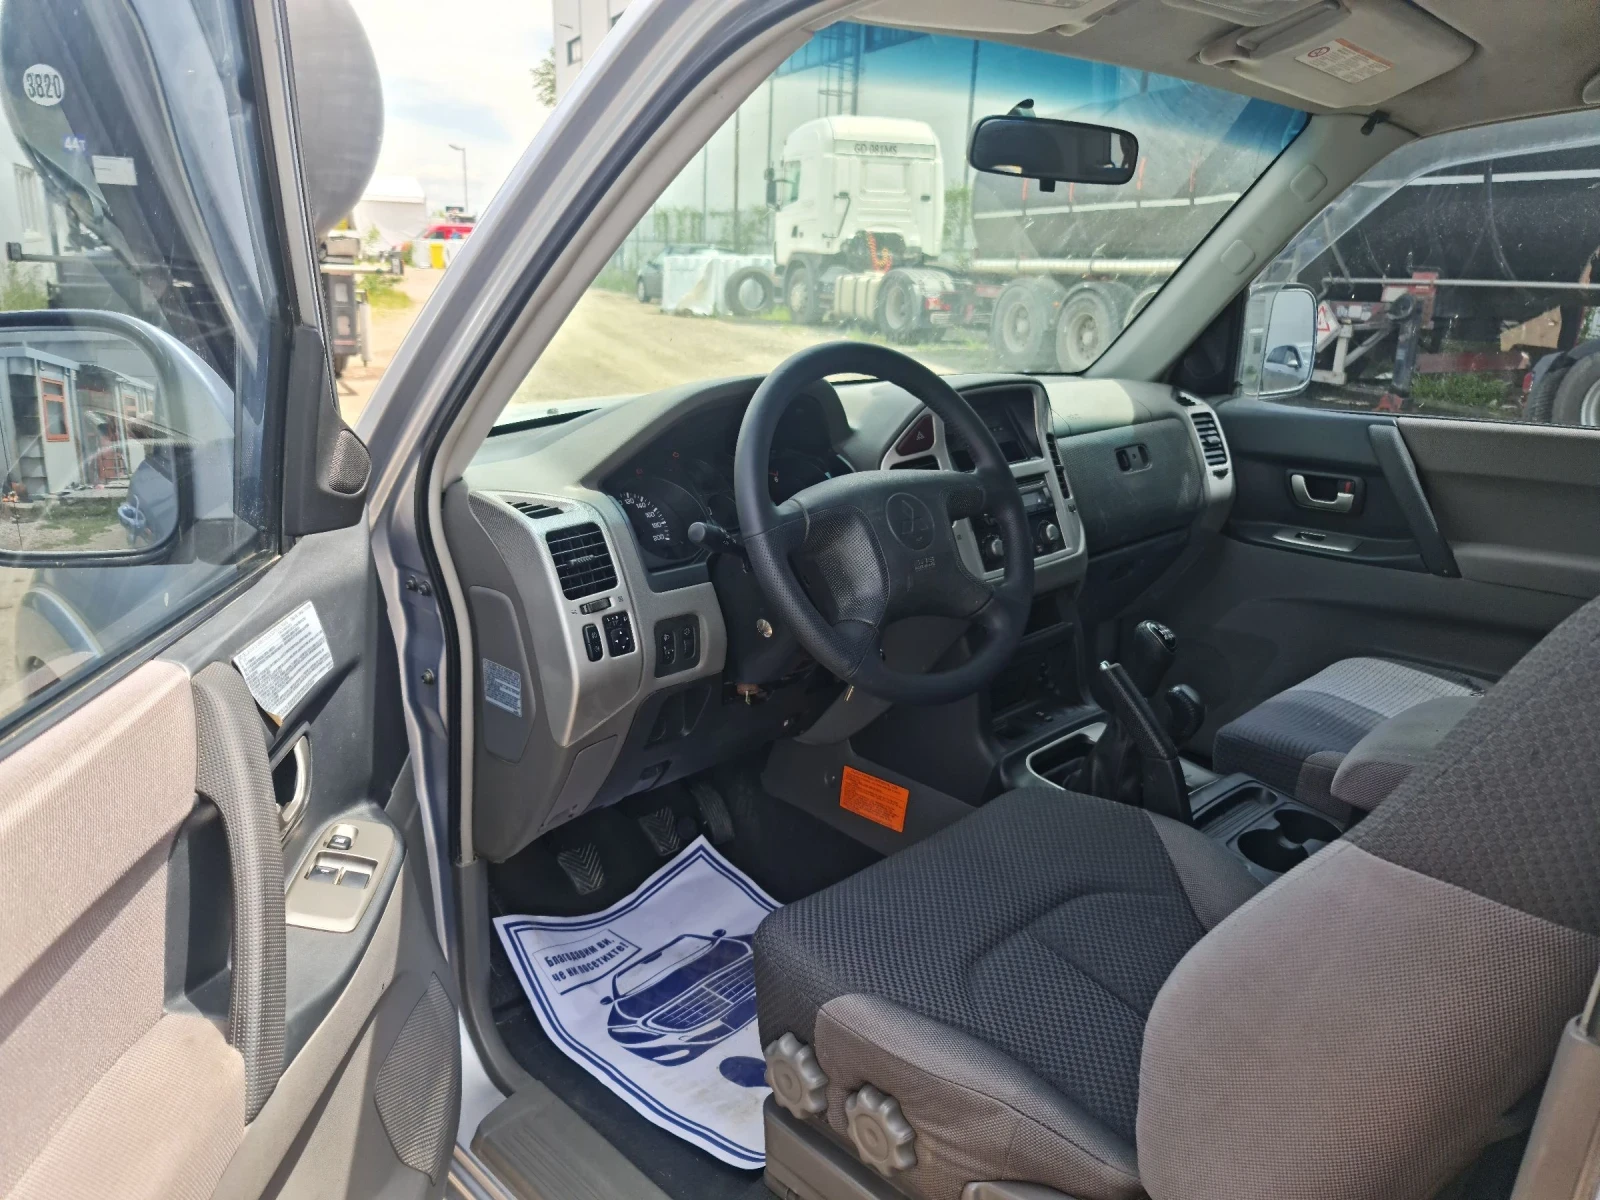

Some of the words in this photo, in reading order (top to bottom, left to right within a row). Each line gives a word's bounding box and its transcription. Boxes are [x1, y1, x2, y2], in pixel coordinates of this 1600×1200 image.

[26, 73, 62, 98] 3820
[544, 945, 599, 968] Благодарим
[551, 970, 567, 982] че
[577, 941, 629, 975] посетихте!
